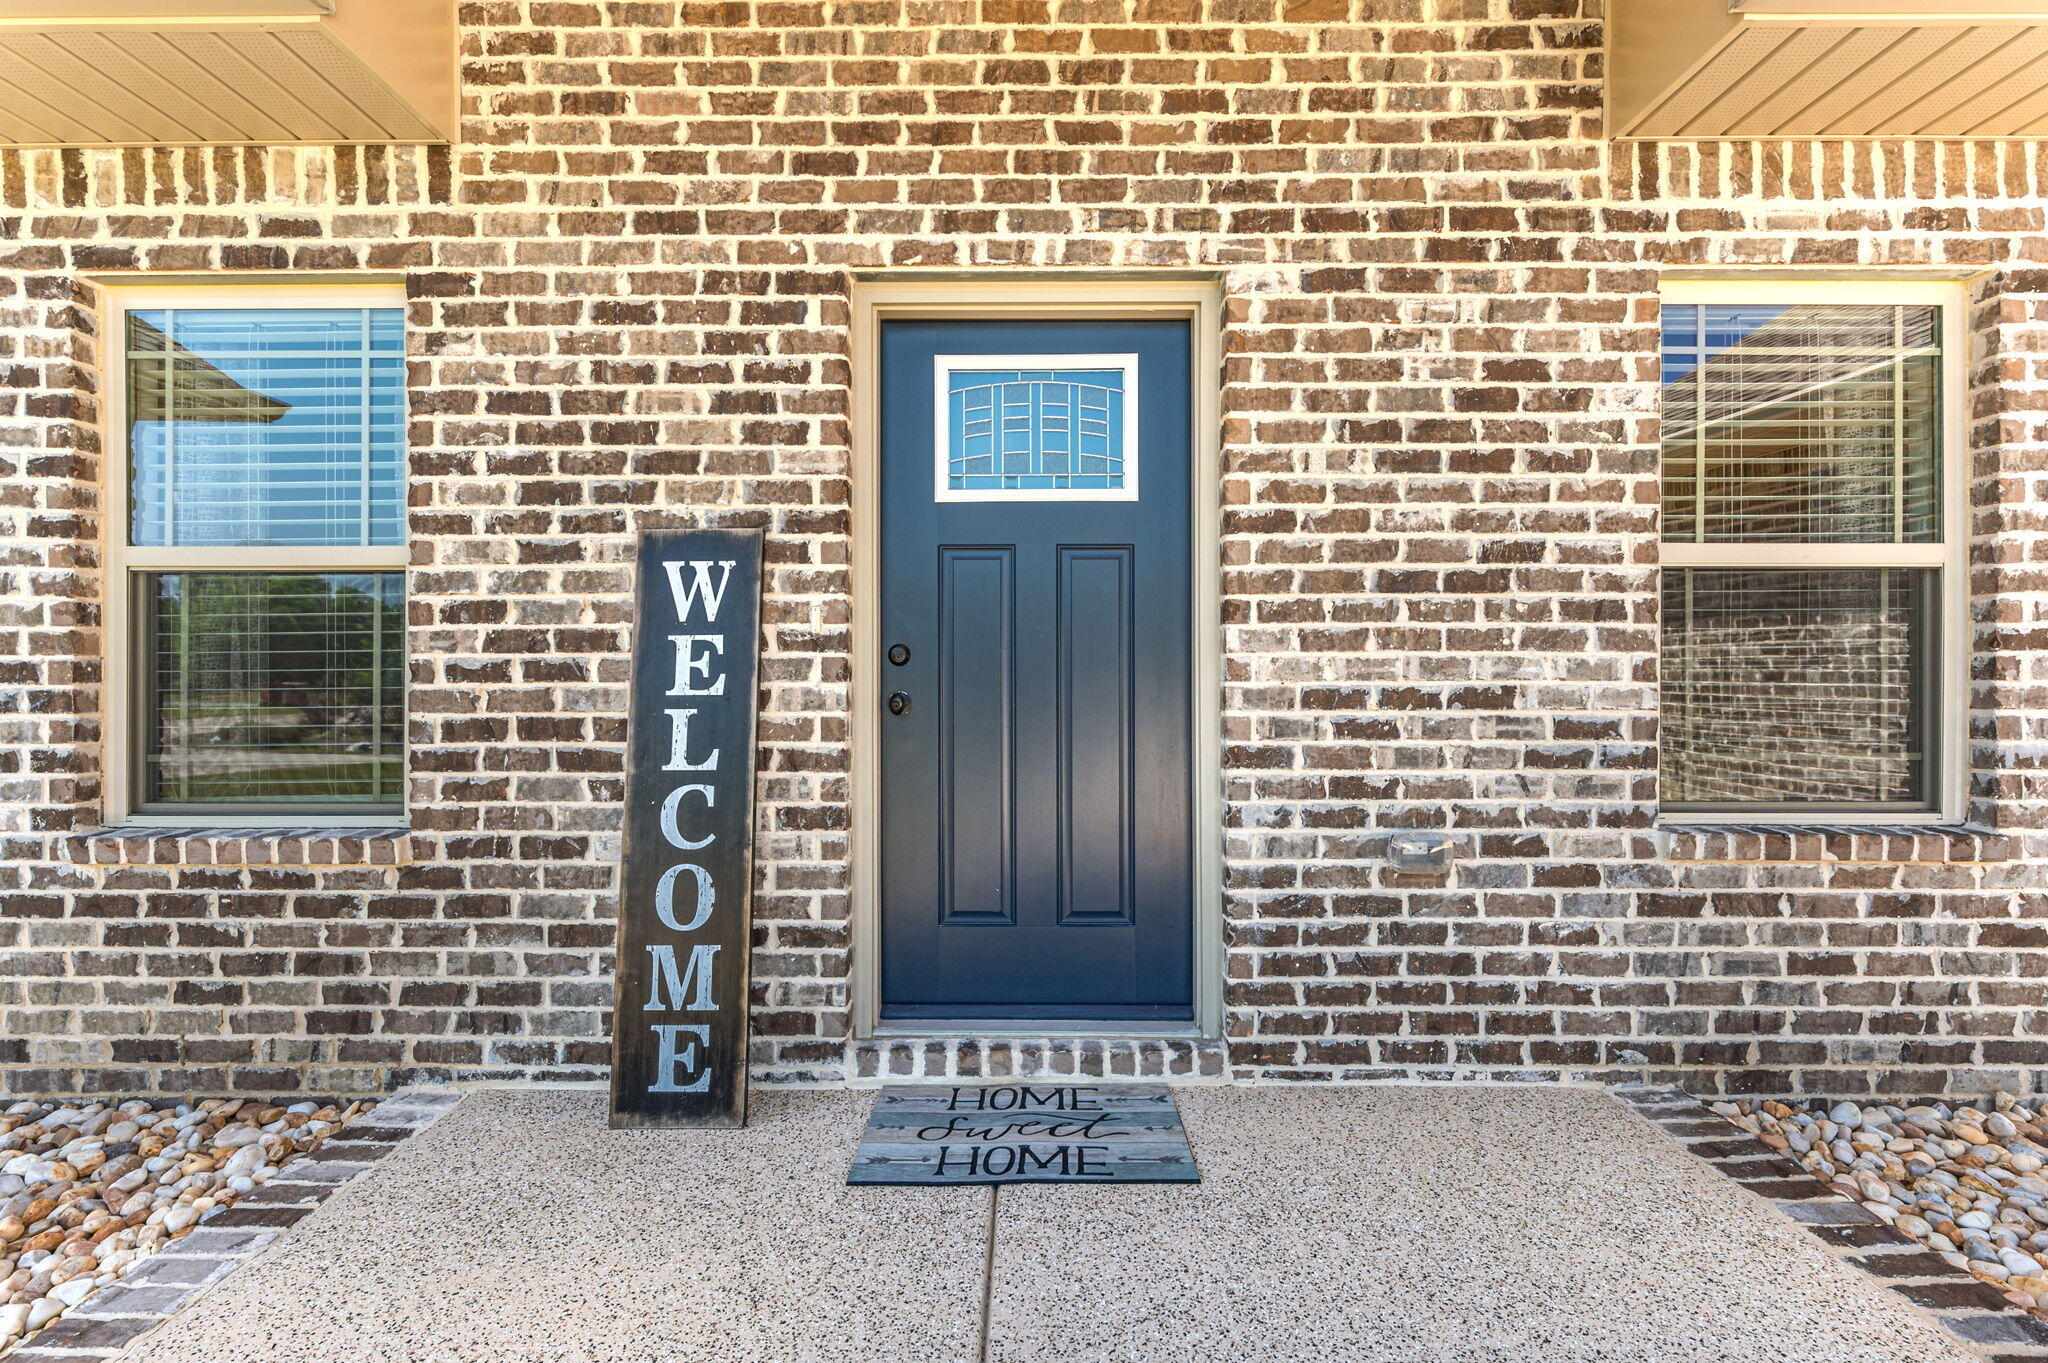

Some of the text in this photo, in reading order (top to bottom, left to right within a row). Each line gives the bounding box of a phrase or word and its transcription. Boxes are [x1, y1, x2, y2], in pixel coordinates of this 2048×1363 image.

[643, 560, 736, 1093] WELCOME
[946, 1086, 1104, 1111] HOME
[933, 1144, 1115, 1176] HOME
